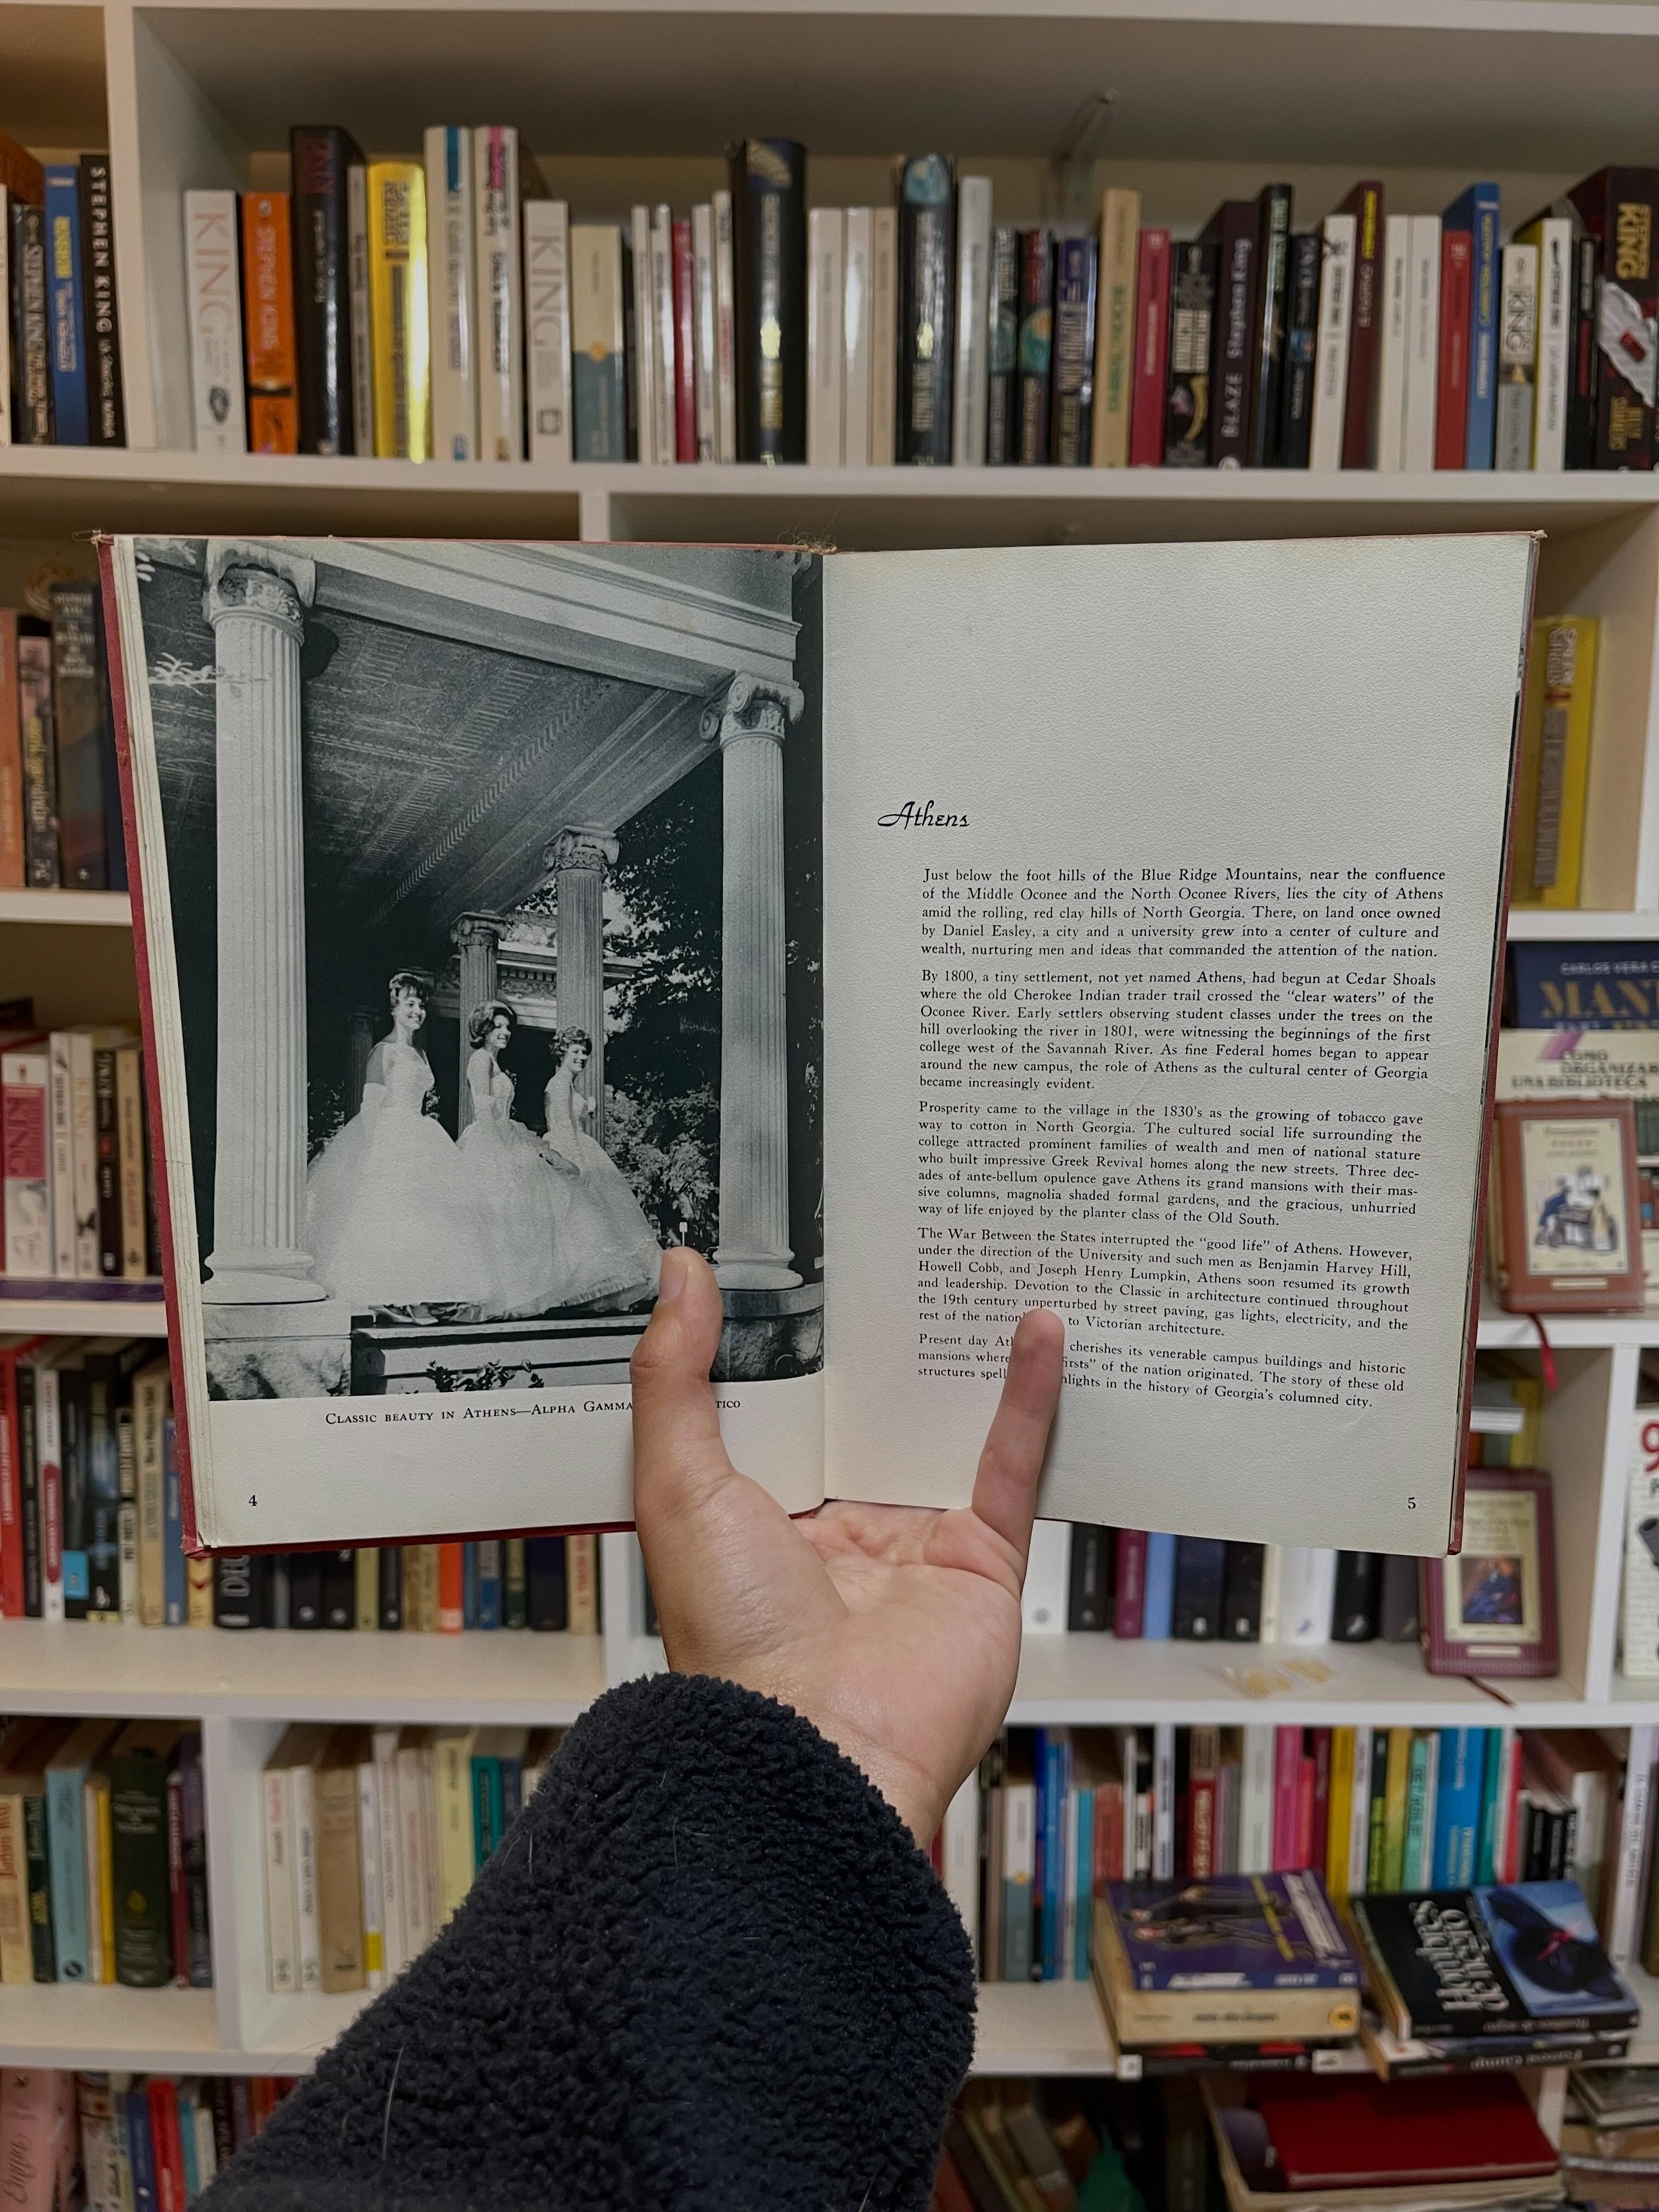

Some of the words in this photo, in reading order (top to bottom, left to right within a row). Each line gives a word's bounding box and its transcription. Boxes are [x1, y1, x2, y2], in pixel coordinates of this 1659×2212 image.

[88, 166, 109, 268] STEPHEN
[1616, 202, 1639, 279] KING
[195, 211, 234, 335] KING
[93, 275, 112, 334] KING
[531, 234, 563, 347] KING
[1227, 285, 1246, 359] Stephen
[1221, 373, 1243, 438] BLAZE
[878, 800, 969, 830] Athens
[923, 868, 949, 883] Just
[956, 868, 992, 882] below
[1000, 868, 1019, 882] the
[1026, 868, 1052, 882] foot
[1058, 868, 1086, 882] hills
[1092, 868, 1106, 882] of
[1114, 868, 1133, 881] the
[1141, 868, 1171, 881] Blue
[1178, 868, 1217, 883] Ridge
[1225, 867, 1301, 882] Mountains,
[1310, 871, 1339, 880] near
[1347, 867, 1367, 880] the
[1375, 867, 1446, 881] confluence
[922, 923, 936, 939] by
[943, 924, 984, 936] Daniel
[991, 924, 1035, 940] Easley,
[1056, 925, 1079, 940] city
[1086, 925, 1109, 937] and
[1131, 924, 1195, 939] university
[1201, 928, 1235, 940] grew
[1242, 924, 1268, 937] into
[1274, 928, 1283, 936] a
[1290, 927, 1331, 937] center
[1338, 925, 1352, 937] of
[1358, 924, 1407, 938] culture
[1414, 926, 1439, 938] and
[922, 969, 939, 984] By
[945, 969, 977, 985] 1800,
[983, 974, 989, 982] a
[995, 970, 1019, 985] tiny
[1024, 970, 1092, 985] settlement,
[1098, 974, 1119, 983] not
[1124, 973, 1144, 985] yet
[1149, 971, 1190, 983] named
[1196, 970, 1246, 986] Athens,
[1252, 971, 1275, 984] had
[1282, 972, 1321, 986] begun
[1326, 974, 1340, 984] at
[1346, 972, 1387, 985] Cedar
[1393, 972, 1436, 986] Shoals
[920, 1022, 940, 1035] hill
[946, 1023, 1018, 1039] overlooking
[1024, 1024, 1043, 1036] the
[1049, 1024, 1079, 1036] river
[1085, 1025, 1096, 1036] in
[1104, 1024, 1137, 1039] 1801,
[1181, 1025, 1249, 1041] witnessing
[1255, 1026, 1274, 1039] the
[1281, 1026, 1350, 1042] beginnings
[1356, 1028, 1370, 1040] of
[1377, 1028, 1397, 1041] the
[1404, 1029, 1431, 1042] first
[919, 1101, 980, 1116] Prosperity
[1025, 1106, 1036, 1114] to
[1043, 1103, 1062, 1115] the
[1068, 1103, 1110, 1118] village
[1117, 1104, 1128, 1116] in
[1136, 1104, 1155, 1116] the
[1210, 1110, 1222, 1118] as
[1229, 1106, 1249, 1119] the
[1255, 1108, 1310, 1124] growing
[1317, 1110, 1330, 1121] of
[1338, 1110, 1386, 1124] tobacco
[1393, 1115, 1423, 1126] gave
[918, 1152, 943, 1164] who
[950, 1153, 978, 1165] built
[984, 1153, 1045, 1167] impressive
[1052, 1155, 1089, 1167] Greek
[1096, 1155, 1143, 1168] Revival
[1150, 1156, 1188, 1170] homes
[1194, 1159, 1229, 1173] along
[1235, 1160, 1255, 1172] the
[1261, 1165, 1288, 1173] new
[1294, 1165, 1338, 1176] streets.
[1345, 1164, 1386, 1177] Three
[1393, 1166, 1420, 1178] dec-
[918, 1244, 952, 1255] under
[957, 1244, 975, 1256] the
[980, 1245, 1032, 1257] direction
[1037, 1246, 1049, 1258] of
[1056, 1247, 1074, 1259] the
[1079, 1248, 1143, 1265] University
[1148, 1252, 1171, 1263] and
[1176, 1254, 1203, 1265] such
[1208, 1259, 1234, 1267] men
[1240, 1260, 1252, 1268] as
[1258, 1257, 1319, 1273] Benjamin
[1325, 1261, 1374, 1277] Harvey
[1380, 1263, 1410, 1279] Hill,
[918, 1260, 962, 1272] Howell
[968, 1261, 1003, 1276] Cobb,
[1009, 1263, 1030, 1274] and
[1036, 1263, 1076, 1277] Joseph
[1084, 1265, 1124, 1280] Henry
[1130, 1267, 1190, 1284] Lumpkin,
[1197, 1272, 1242, 1285] Athens
[1248, 1278, 1275, 1287] soon
[1283, 1278, 1335, 1290] resumed
[1342, 1279, 1356, 1291] its
[1363, 1283, 1409, 1295] growth
[1070, 1340, 1122, 1355] cherishes
[1128, 1344, 1143, 1356] its
[1149, 1348, 1207, 1361] venerable
[1213, 1354, 1259, 1365] campus
[1265, 1353, 1322, 1371] buildings
[1329, 1359, 1351, 1370] and
[1359, 1359, 1406, 1374] historic
[326, 1413, 376, 1424] CLASSIC
[385, 1413, 433, 1421] BEAUTY
[463, 1404, 575, 1418] ATHENS—ALPHA
[584, 1401, 632, 1412] GAMMA
[249, 1495, 257, 1506] 4
[1408, 1497, 1415, 1509] 5
